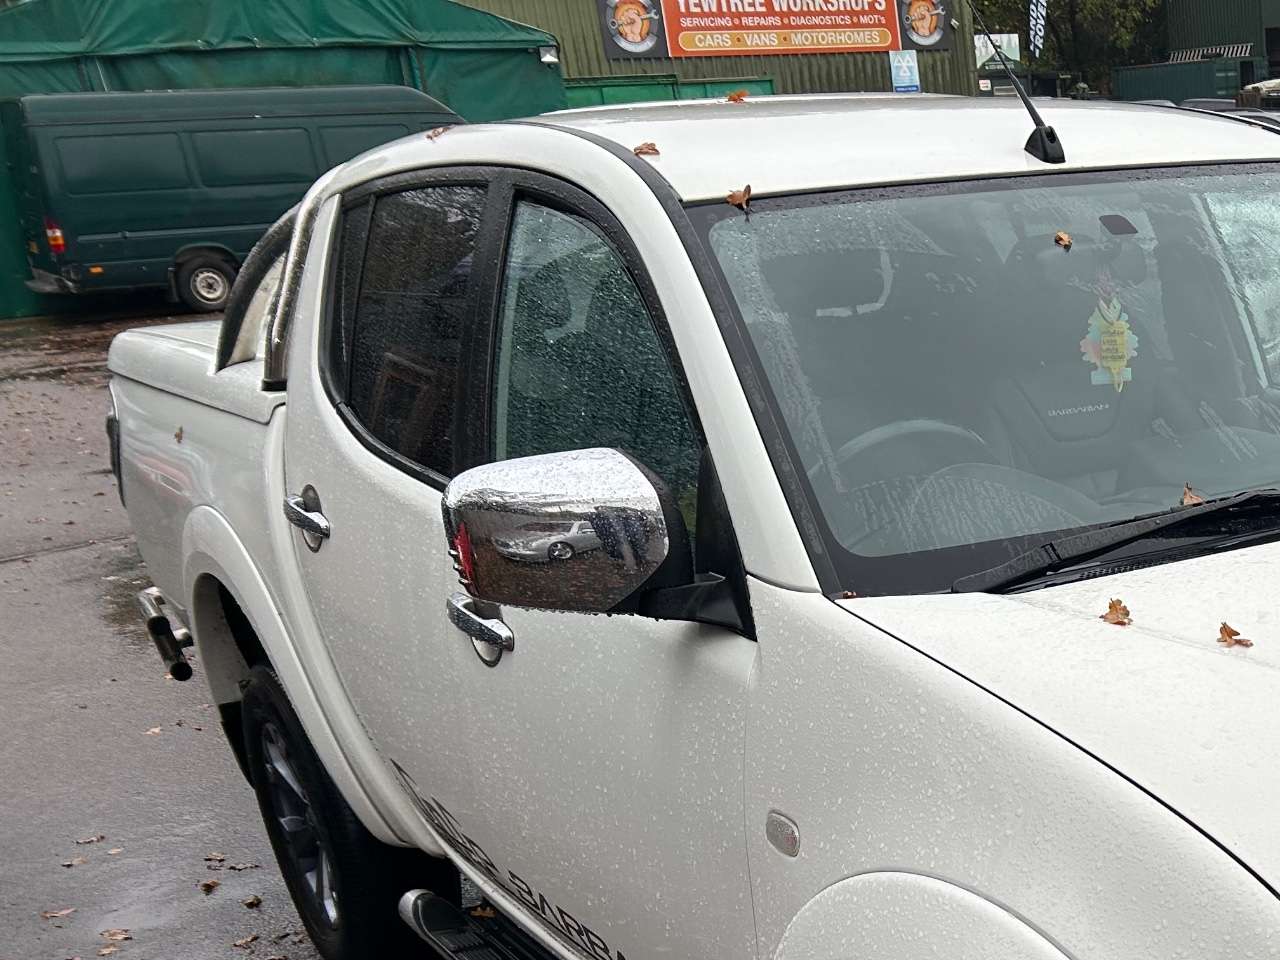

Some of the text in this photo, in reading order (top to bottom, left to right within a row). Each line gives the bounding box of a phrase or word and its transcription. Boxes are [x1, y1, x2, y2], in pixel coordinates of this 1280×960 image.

[680, 14, 886, 27] SERVICING REPAIRS DIAGNOSTICS MOT's
[695, 31, 880, 47] CARS VANS MOTORHOMES
